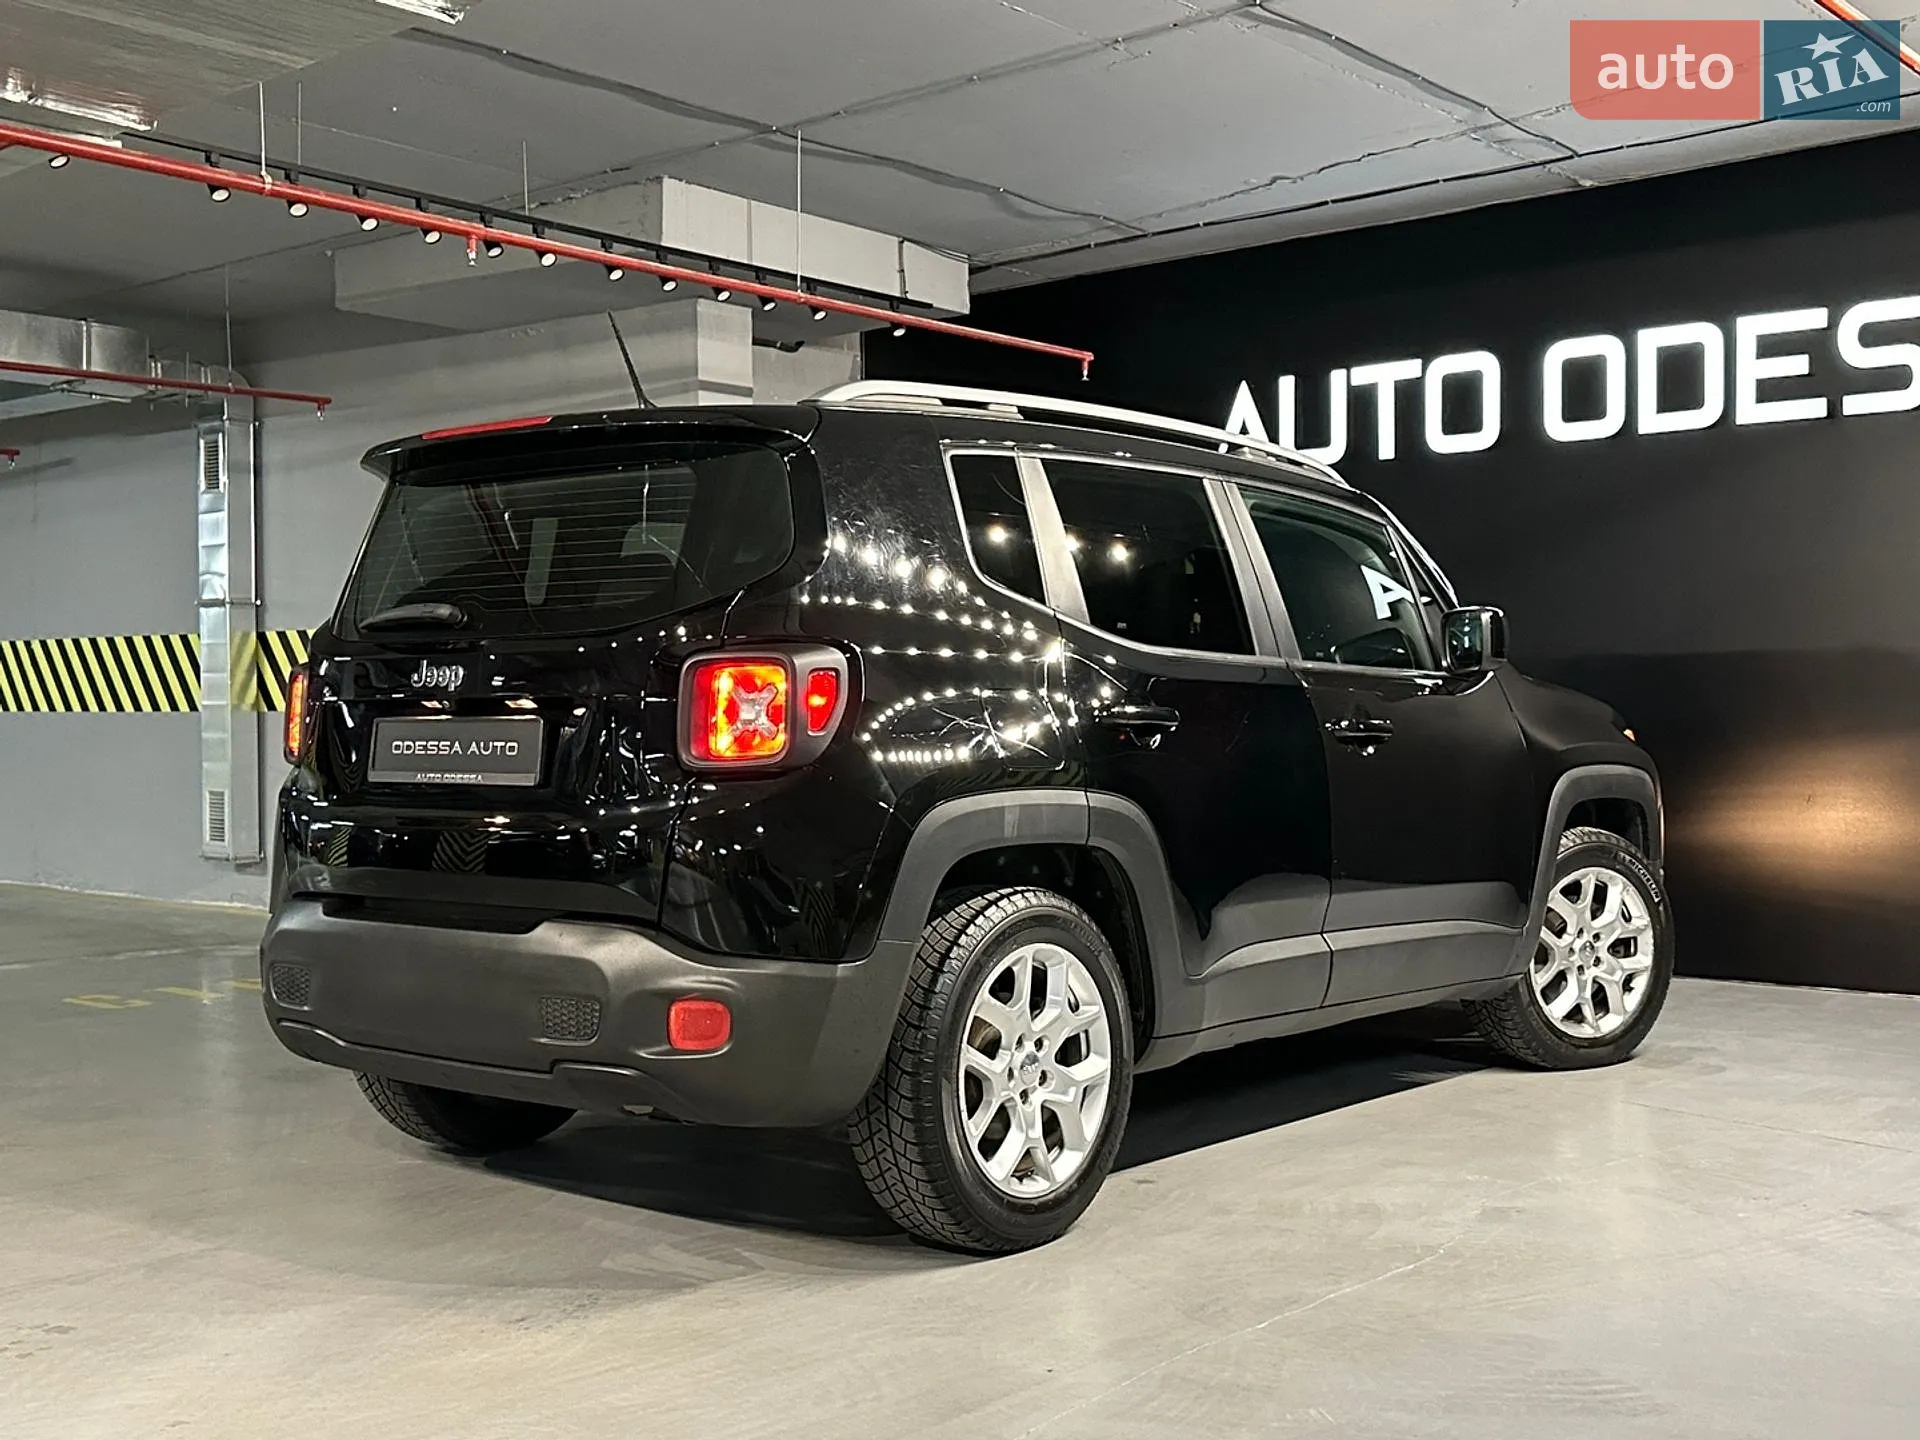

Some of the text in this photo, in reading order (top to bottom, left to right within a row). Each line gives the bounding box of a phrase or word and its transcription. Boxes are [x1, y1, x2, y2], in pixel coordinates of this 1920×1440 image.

[1217, 295, 1920, 465] AUTO ODES
[411, 659, 464, 692] Jeep
[391, 740, 519, 756] ODESSA AUTO
[415, 773, 484, 784] AUTO ODESSA
[1625, 858, 1660, 900] MICHELIN
